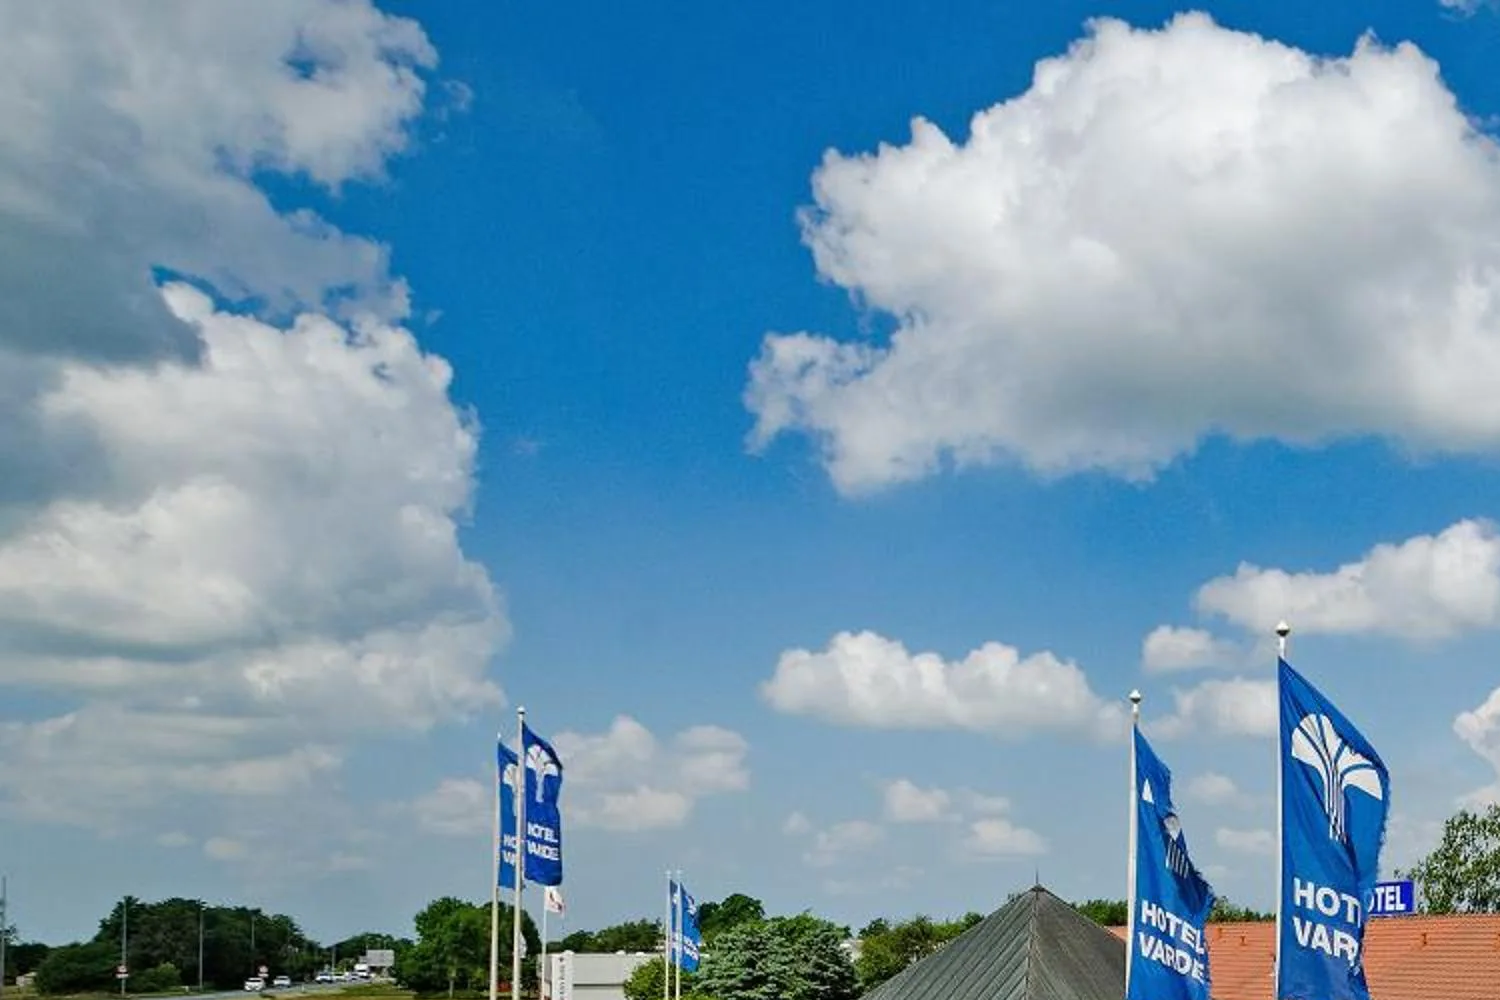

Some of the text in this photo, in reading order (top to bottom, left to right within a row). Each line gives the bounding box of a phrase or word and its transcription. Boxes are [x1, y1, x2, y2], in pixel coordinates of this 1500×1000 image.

[1293, 877, 1361, 928] HOT
[1364, 885, 1406, 912] OTEL
[1141, 900, 1205, 954] HOTEL
[1292, 915, 1360, 976] VAR
[1138, 932, 1206, 985] VARDE
